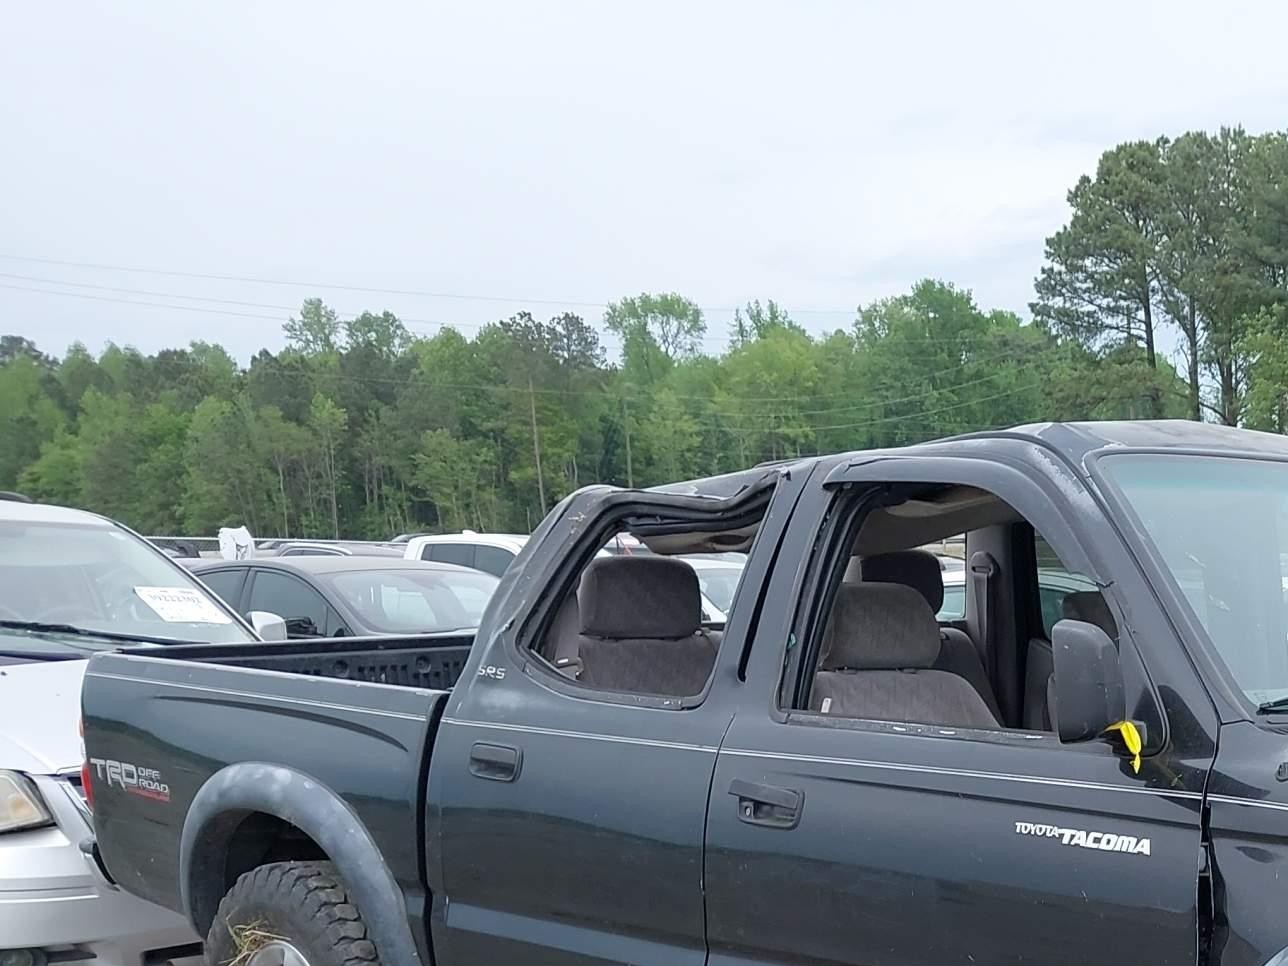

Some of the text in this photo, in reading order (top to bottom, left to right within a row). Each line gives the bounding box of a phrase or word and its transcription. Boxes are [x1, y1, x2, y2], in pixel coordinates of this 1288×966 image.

[90, 757, 138, 792] TRD
[138, 767, 161, 780] OFF
[138, 779, 169, 794] ROAD
[1015, 822, 1151, 856] TOYOTA TACOMA
